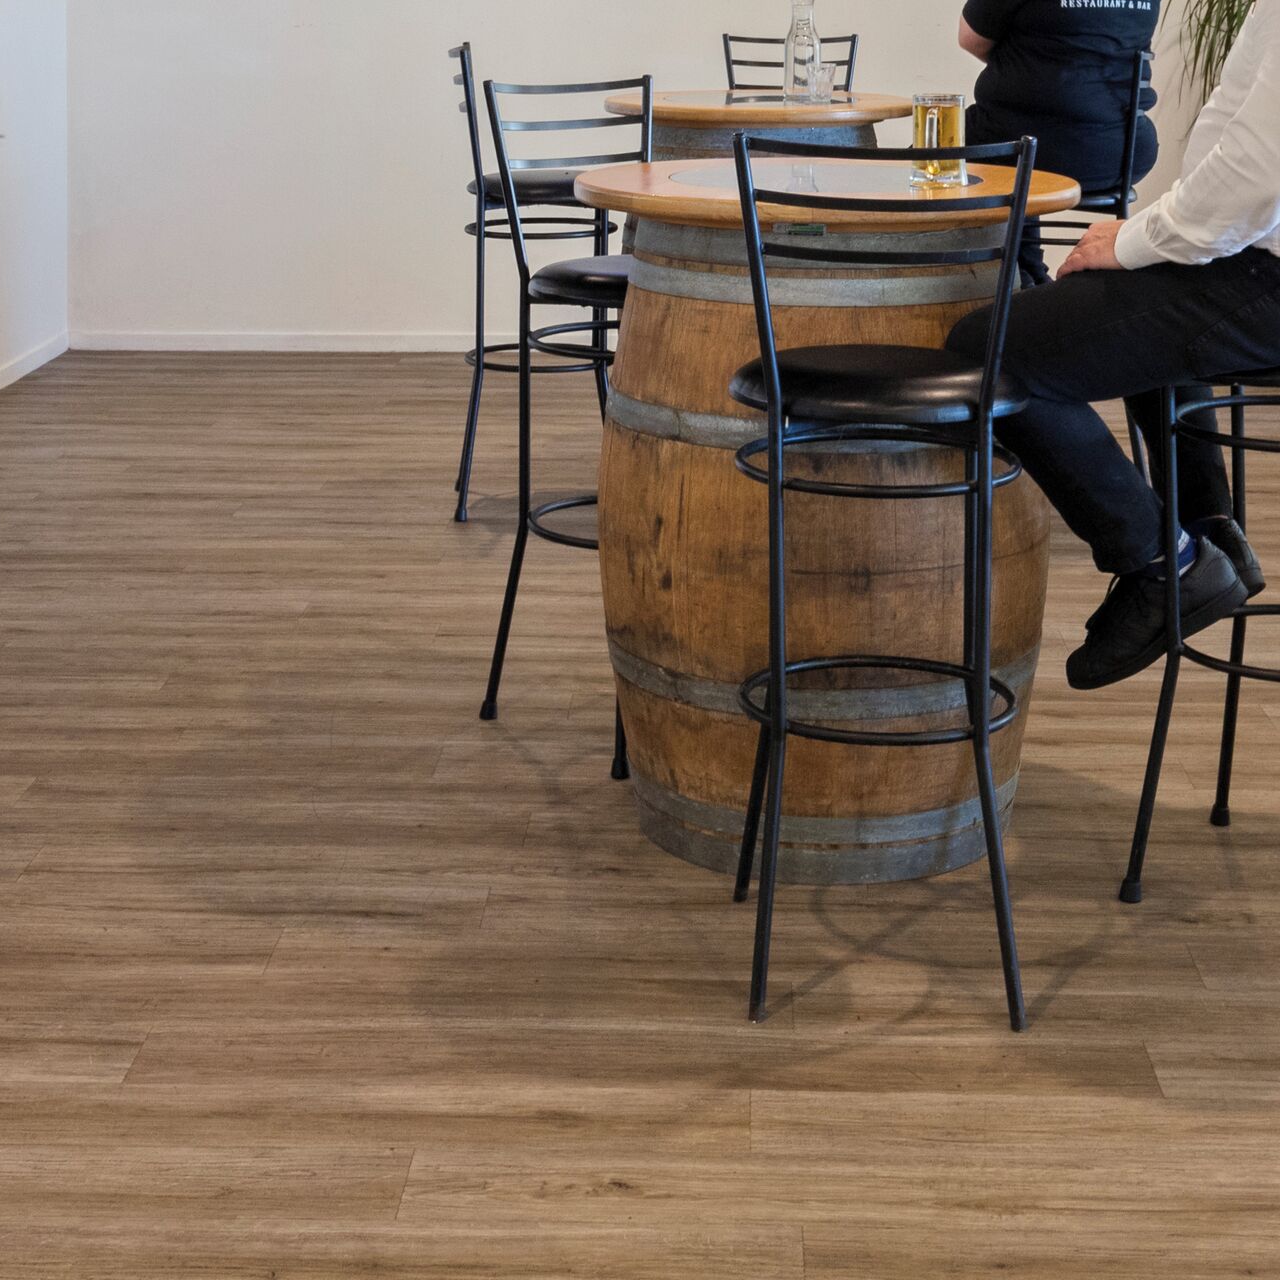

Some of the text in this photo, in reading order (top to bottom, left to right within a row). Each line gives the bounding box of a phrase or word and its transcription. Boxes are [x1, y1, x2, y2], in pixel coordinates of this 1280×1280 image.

[1060, 0, 1151, 11] RESTAURANT & BAR
